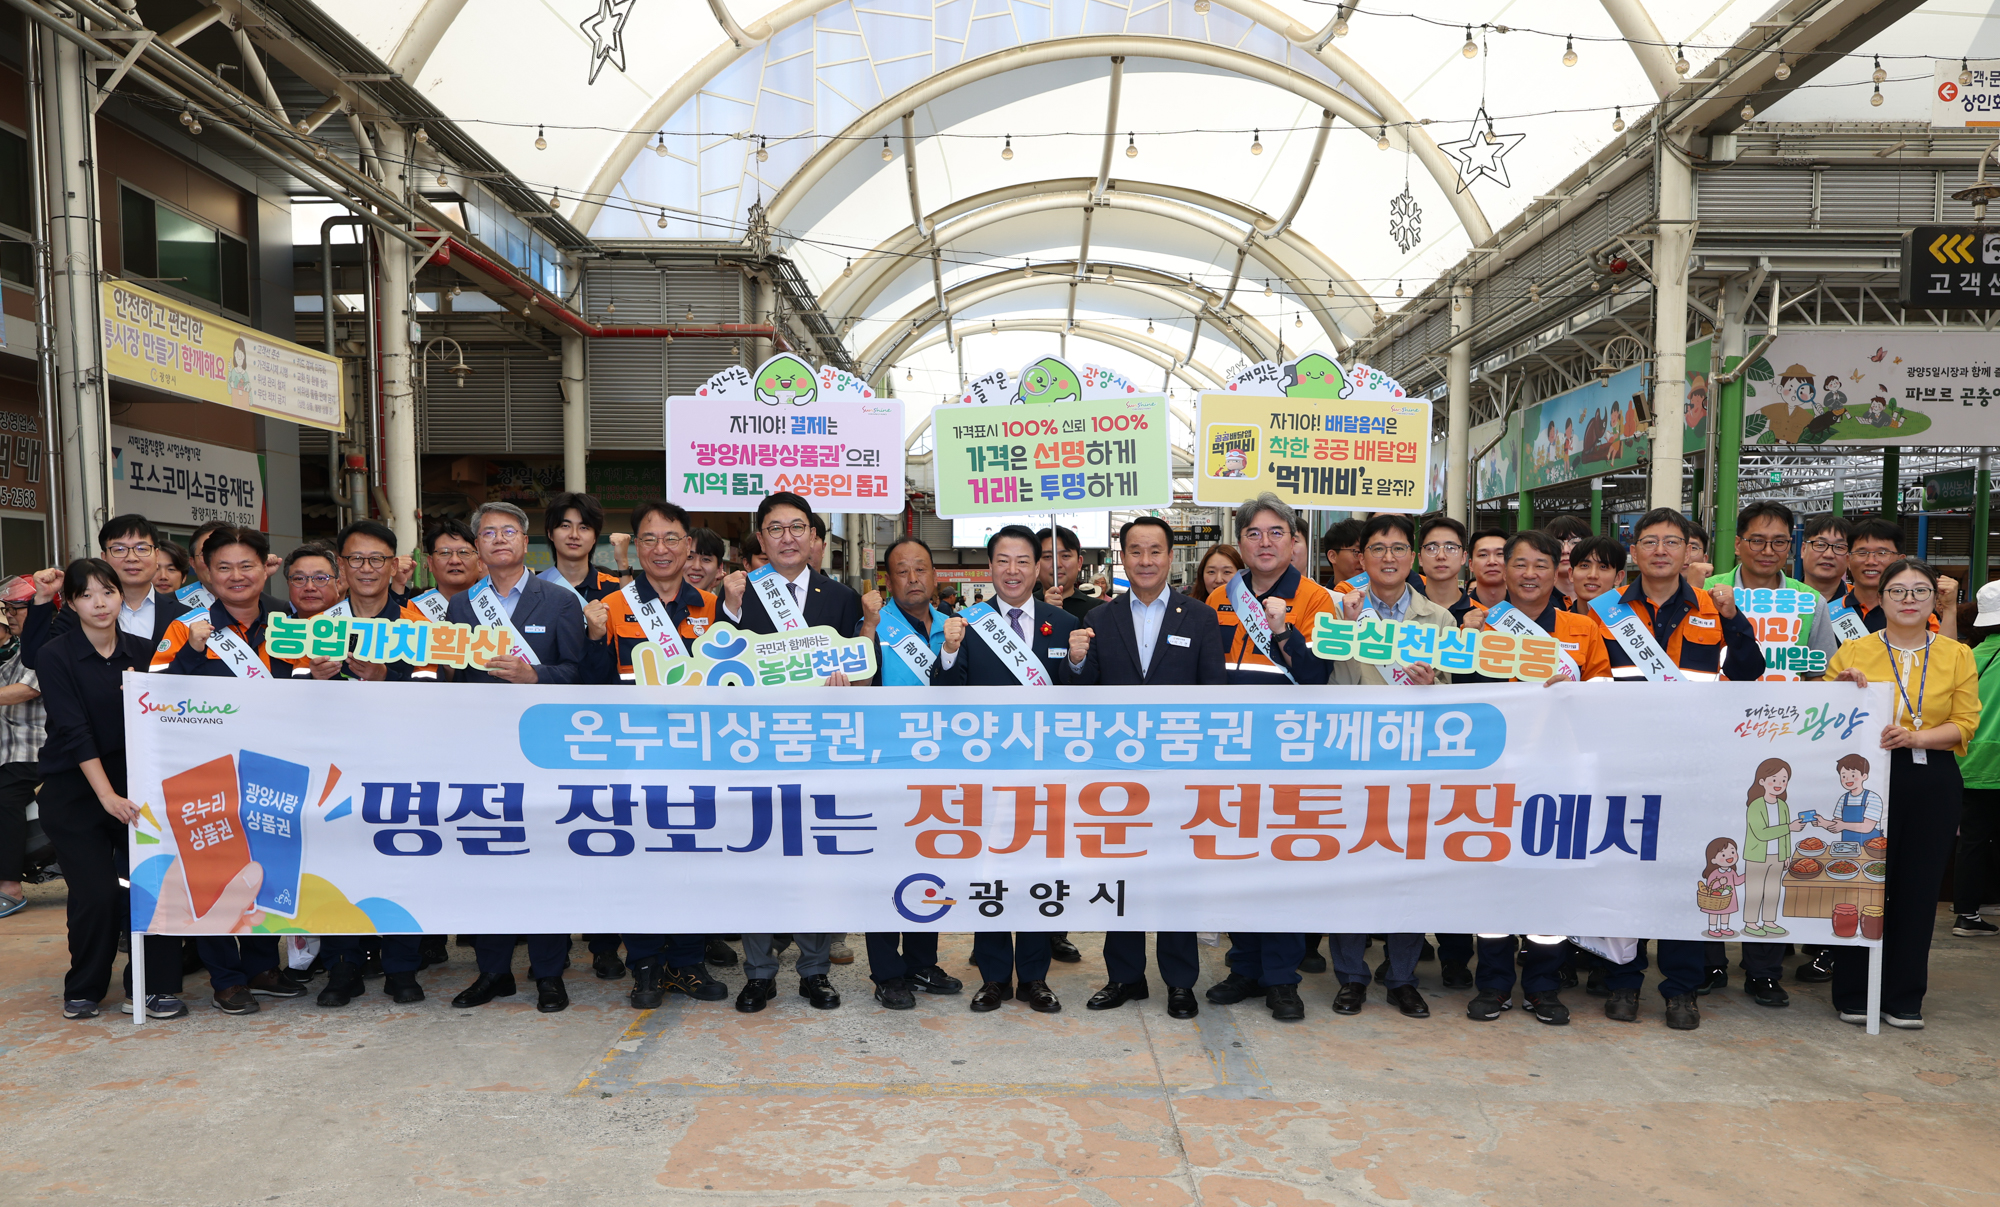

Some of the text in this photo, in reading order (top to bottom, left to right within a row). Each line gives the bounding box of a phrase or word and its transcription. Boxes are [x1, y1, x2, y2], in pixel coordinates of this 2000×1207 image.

[1962, 70, 2000, 87] 객·문
[113, 288, 204, 345] 안전하고 편리한
[142, 331, 179, 370] 만들기
[181, 345, 227, 381] 함께해요
[710, 368, 749, 395] 신나는
[820, 368, 865, 394] 광양시
[1083, 366, 1127, 390] 광양시
[1237, 366, 1279, 384] 재밌는
[1353, 366, 1396, 393] 광양시
[1907, 366, 1969, 378] 광양5일시장과
[1972, 365, 1992, 378] 함께
[971, 371, 1007, 404] 즐거운
[1905, 387, 1954, 402] 파브르
[730, 415, 838, 436] 자기야! 결제는
[953, 413, 1149, 440] 가격표시 100% 신뢰 100%
[1215, 429, 1252, 442] 공공배달앱
[1270, 412, 1398, 436] 자기야! 배달음식은
[128, 436, 201, 461] 서민금융진흥원 사업수행기관
[966, 438, 1137, 473] 가격은 선명하게
[1212, 437, 1255, 455] 먹깨비
[1269, 435, 1417, 464] 착한 공공 배달앱
[130, 461, 254, 508] 포스코미소금융재단
[683, 472, 888, 498] 지역 돕고, 소상공인 돕고
[968, 471, 1138, 504] 거래는 투명하게
[1376, 478, 1415, 497] 알쥐?
[1941, 480, 1972, 498] 싱싱농산
[191, 506, 218, 521] 광양지점
[223, 510, 255, 525] 761-8521
[523, 551, 553, 566] 품권
[478, 594, 504, 630] 광양에
[761, 578, 792, 619] 함께하는
[1241, 590, 1270, 630] 전통시장
[270, 616, 512, 666] 농업가치확산
[982, 618, 1028, 667] 광양에서
[1839, 618, 1862, 641] 함께
[659, 631, 680, 658] 소비
[756, 635, 830, 656] 국민과 함께하는
[1316, 616, 1557, 679] 농심천심운동
[1620, 622, 1666, 674] 광양에서
[247, 665, 265, 678] 소
[758, 644, 868, 686] 농심천심
[1766, 646, 1826, 671] 내일은
[138, 692, 240, 715] Sunshine
[160, 715, 224, 725] GWANGYANG
[1734, 719, 1795, 744] 산업수도
[1745, 702, 1870, 742] 대한민국 광양
[563, 708, 1476, 764] 온누리상품권, 광양사랑상품권 함께해요
[180, 791, 227, 826] 온누리
[245, 782, 299, 815] 광양사랑
[189, 817, 235, 852] 상품권
[246, 811, 292, 839] 상품권
[361, 781, 1662, 863] 명절 장보기는 정겨운 전통시장에서
[968, 878, 1126, 918] 광양시
